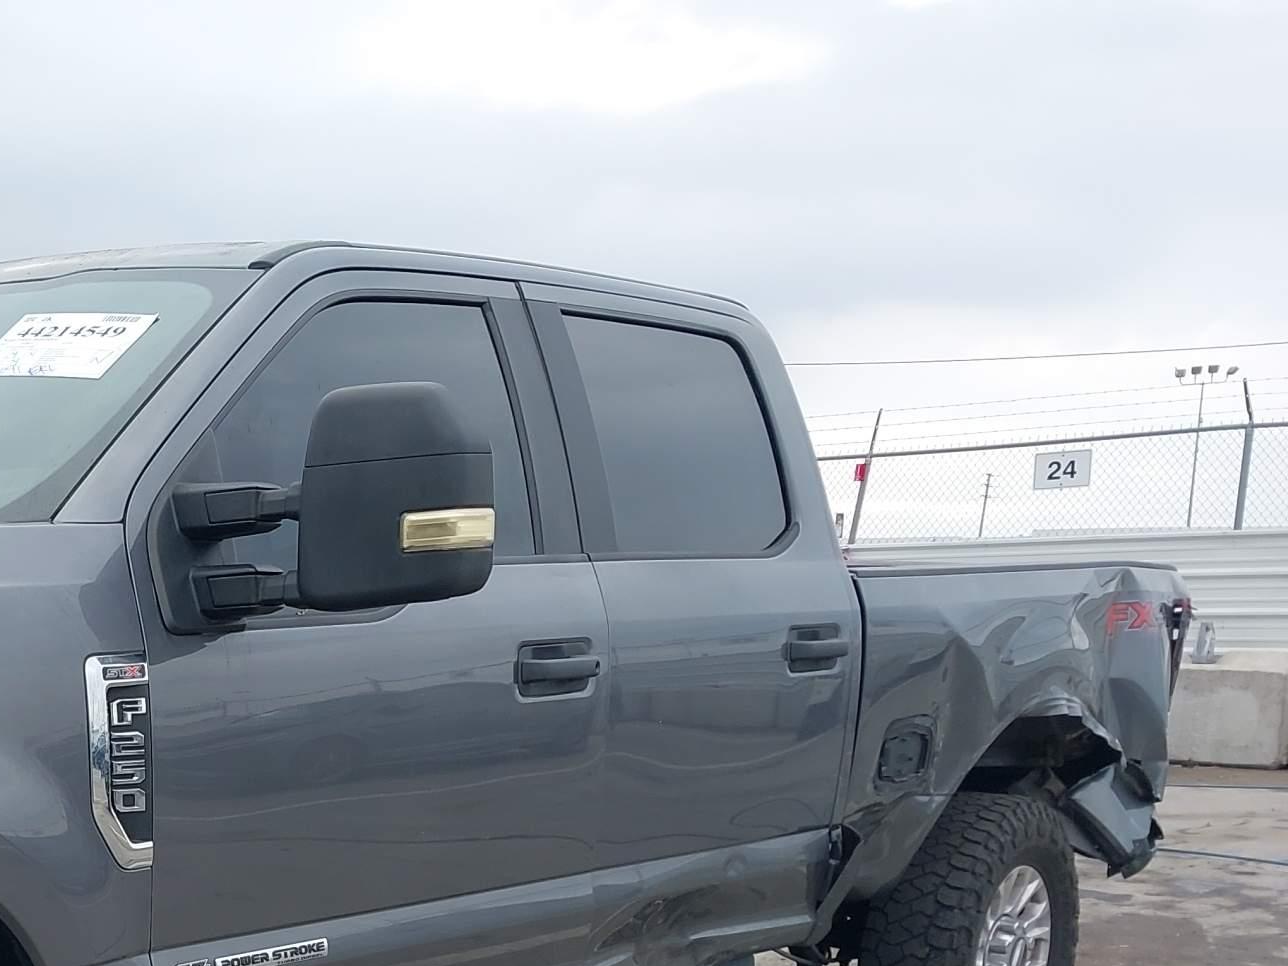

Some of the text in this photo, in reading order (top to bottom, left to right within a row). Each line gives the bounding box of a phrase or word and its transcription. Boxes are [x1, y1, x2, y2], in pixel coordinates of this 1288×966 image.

[17, 325, 127, 338] 44214549
[1047, 460, 1077, 480] 24
[272, 941, 325, 961] STROKE
